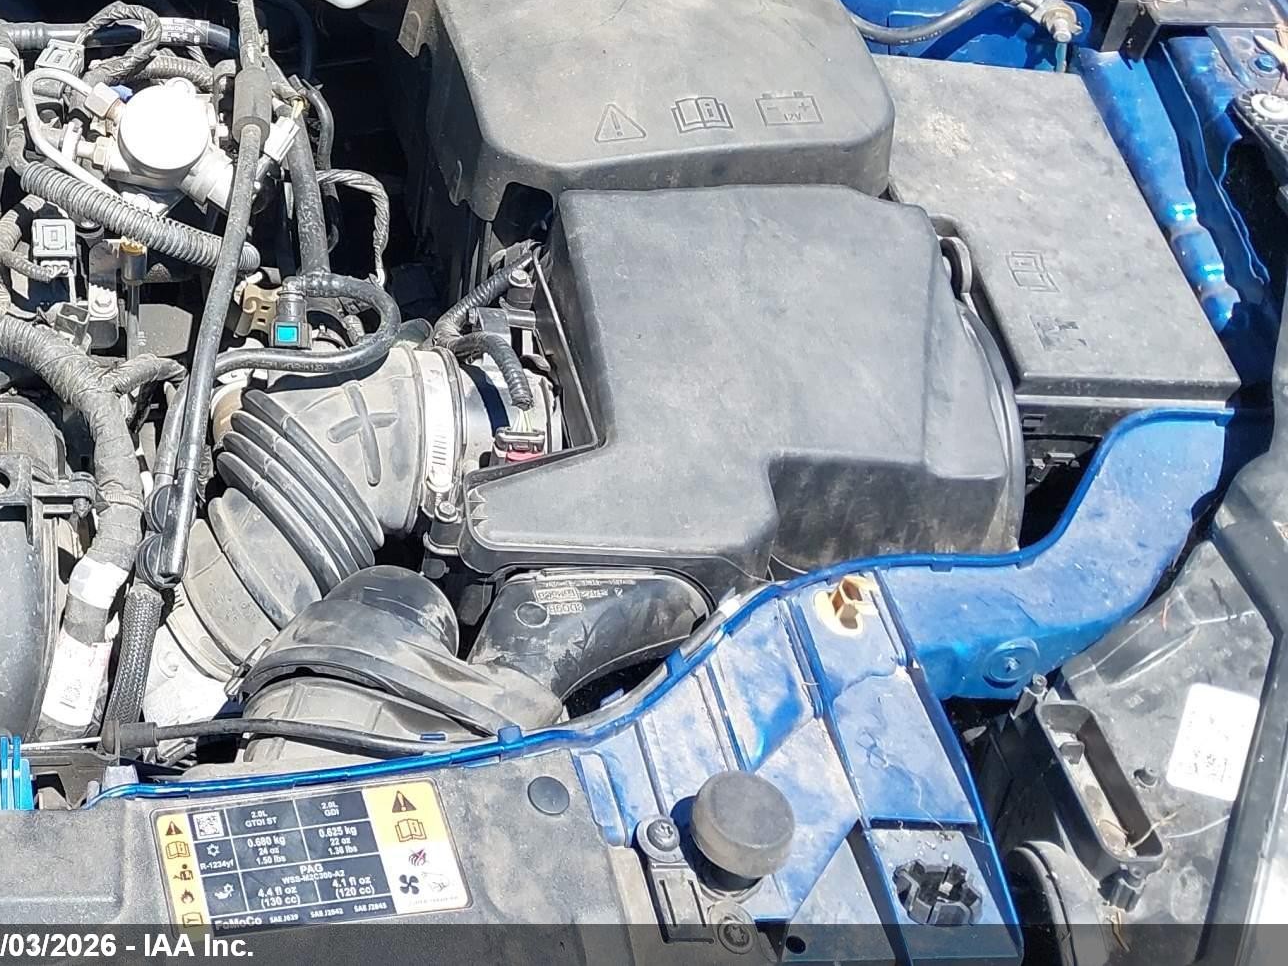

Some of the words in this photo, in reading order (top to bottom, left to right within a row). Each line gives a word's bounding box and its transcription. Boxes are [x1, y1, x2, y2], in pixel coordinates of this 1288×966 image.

[320, 801, 339, 810] 2.0L
[250, 810, 268, 819] 2.0L
[324, 809, 340, 817] GDI
[245, 818, 266, 828] GTDI
[266, 817, 278, 826] ST
[318, 826, 343, 838] 0.625
[344, 825, 358, 836] kg
[247, 836, 272, 848] 0.680
[272, 835, 286, 846] kg
[329, 838, 340, 846] 22
[345, 845, 358, 853] lbs
[199, 859, 234, 871] R-1234yf
[256, 856, 273, 865] 1.50
[273, 855, 287, 864] lbs
[299, 863, 324, 874] PAG
[332, 878, 347, 888] 4.1
[348, 876, 357, 886] fl
[358, 876, 372, 885] oz
[257, 887, 273, 897] 4.4
[274, 886, 283, 896] fl
[284, 886, 298, 894] oz
[335, 887, 357, 900] (120
[358, 883, 375, 895] cc)
[261, 897, 283, 910] (130
[284, 894, 301, 906] cc)
[214, 916, 263, 931] FoMoCo
[353, 904, 367, 913] SAE
